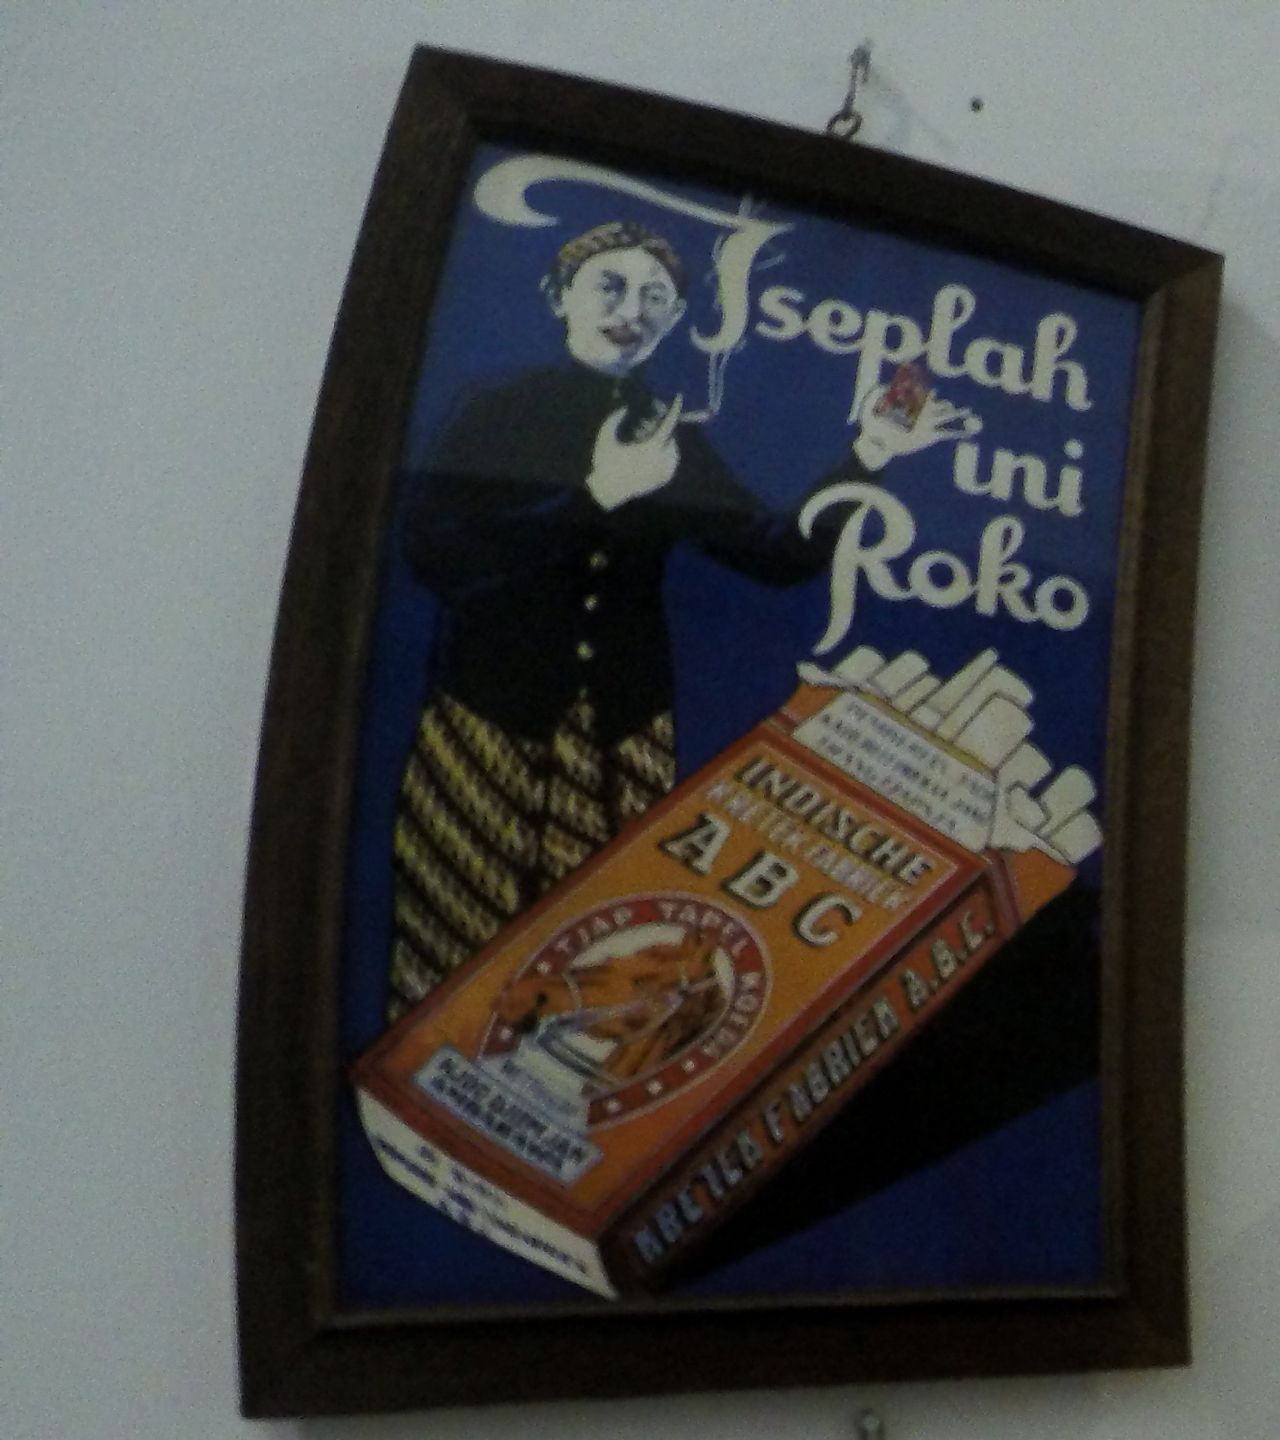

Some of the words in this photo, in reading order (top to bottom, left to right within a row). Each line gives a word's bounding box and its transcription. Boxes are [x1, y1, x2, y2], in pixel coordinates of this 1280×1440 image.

[473, 155, 1093, 423] Tseplah
[955, 415, 1085, 518] ini
[800, 483, 1088, 654] Roko
[737, 757, 933, 885] INDISCHE
